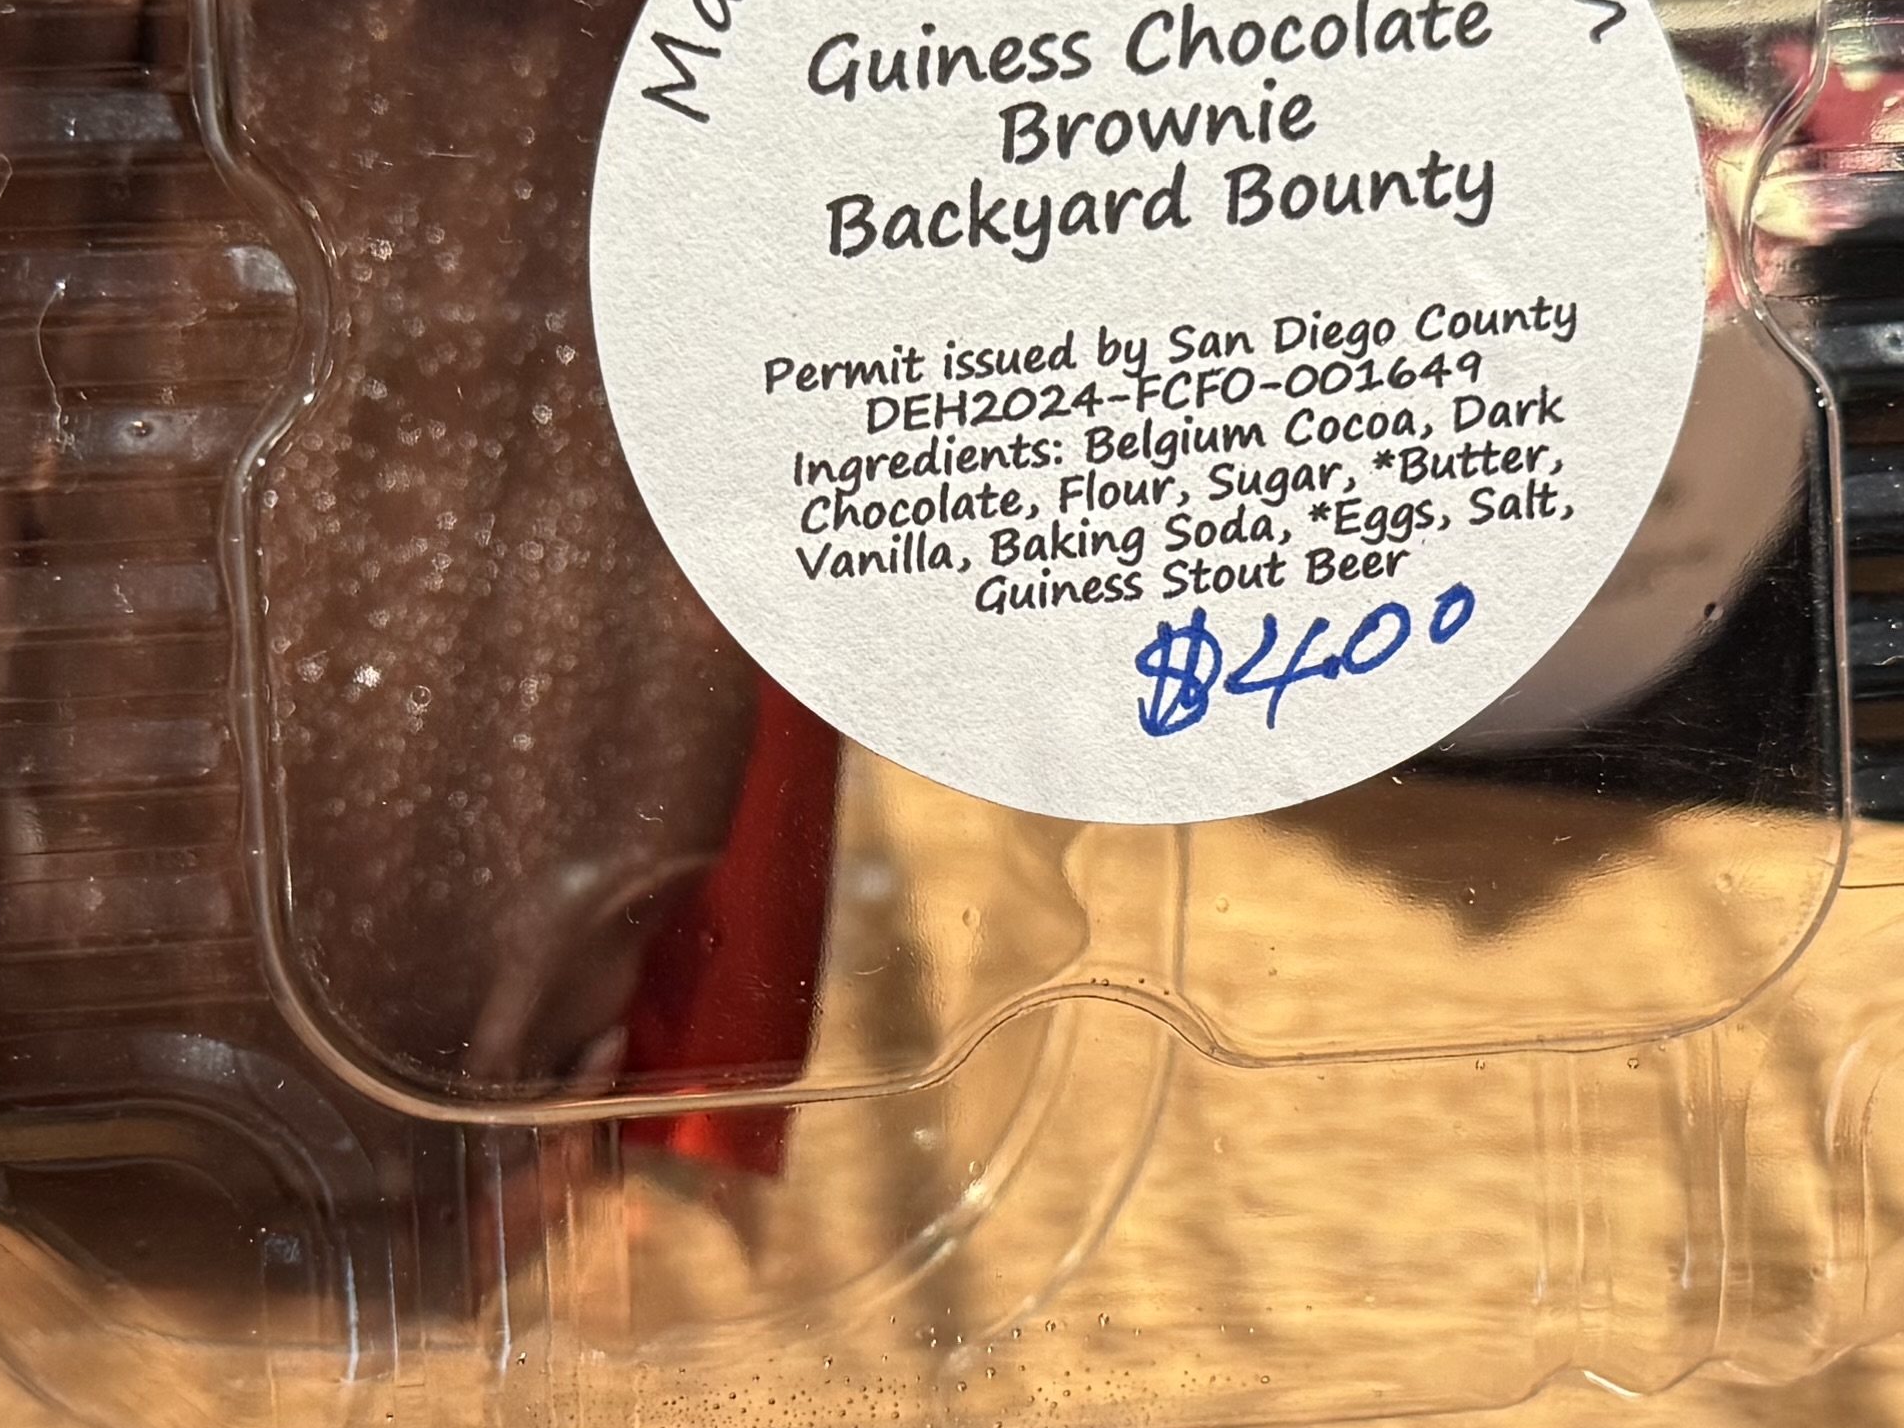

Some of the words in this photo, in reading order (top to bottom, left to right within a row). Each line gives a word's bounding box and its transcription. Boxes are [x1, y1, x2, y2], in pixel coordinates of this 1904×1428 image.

[807, 21, 1094, 103] Guiness
[998, 77, 1318, 166] Brownie
[825, 160, 1192, 264] Backyard
[1224, 149, 1496, 228] Bounty
[764, 344, 925, 395] Permit
[943, 329, 1077, 381] issued
[1097, 325, 1148, 380] by
[1168, 324, 1255, 364] San
[1274, 309, 1396, 360] Diego
[1415, 295, 1578, 343] County
[793, 433, 1064, 495] Ingredients:
[1084, 415, 1266, 471] Belgium
[1284, 407, 1435, 441] Cocoa,
[1452, 384, 1566, 433] Dark
[796, 529, 972, 581] Vanilla,
[990, 519, 1145, 567] Baking
[1164, 503, 1293, 553] Soda,
[1468, 478, 1575, 526] Salt,
[800, 482, 1040, 535] Chocolate,
[1059, 468, 1190, 514] Flour,
[1207, 461, 1356, 508] Sugar,
[975, 567, 1144, 615] Guiness
[1162, 551, 1286, 599] Stout
[1305, 547, 1412, 585] Beer
